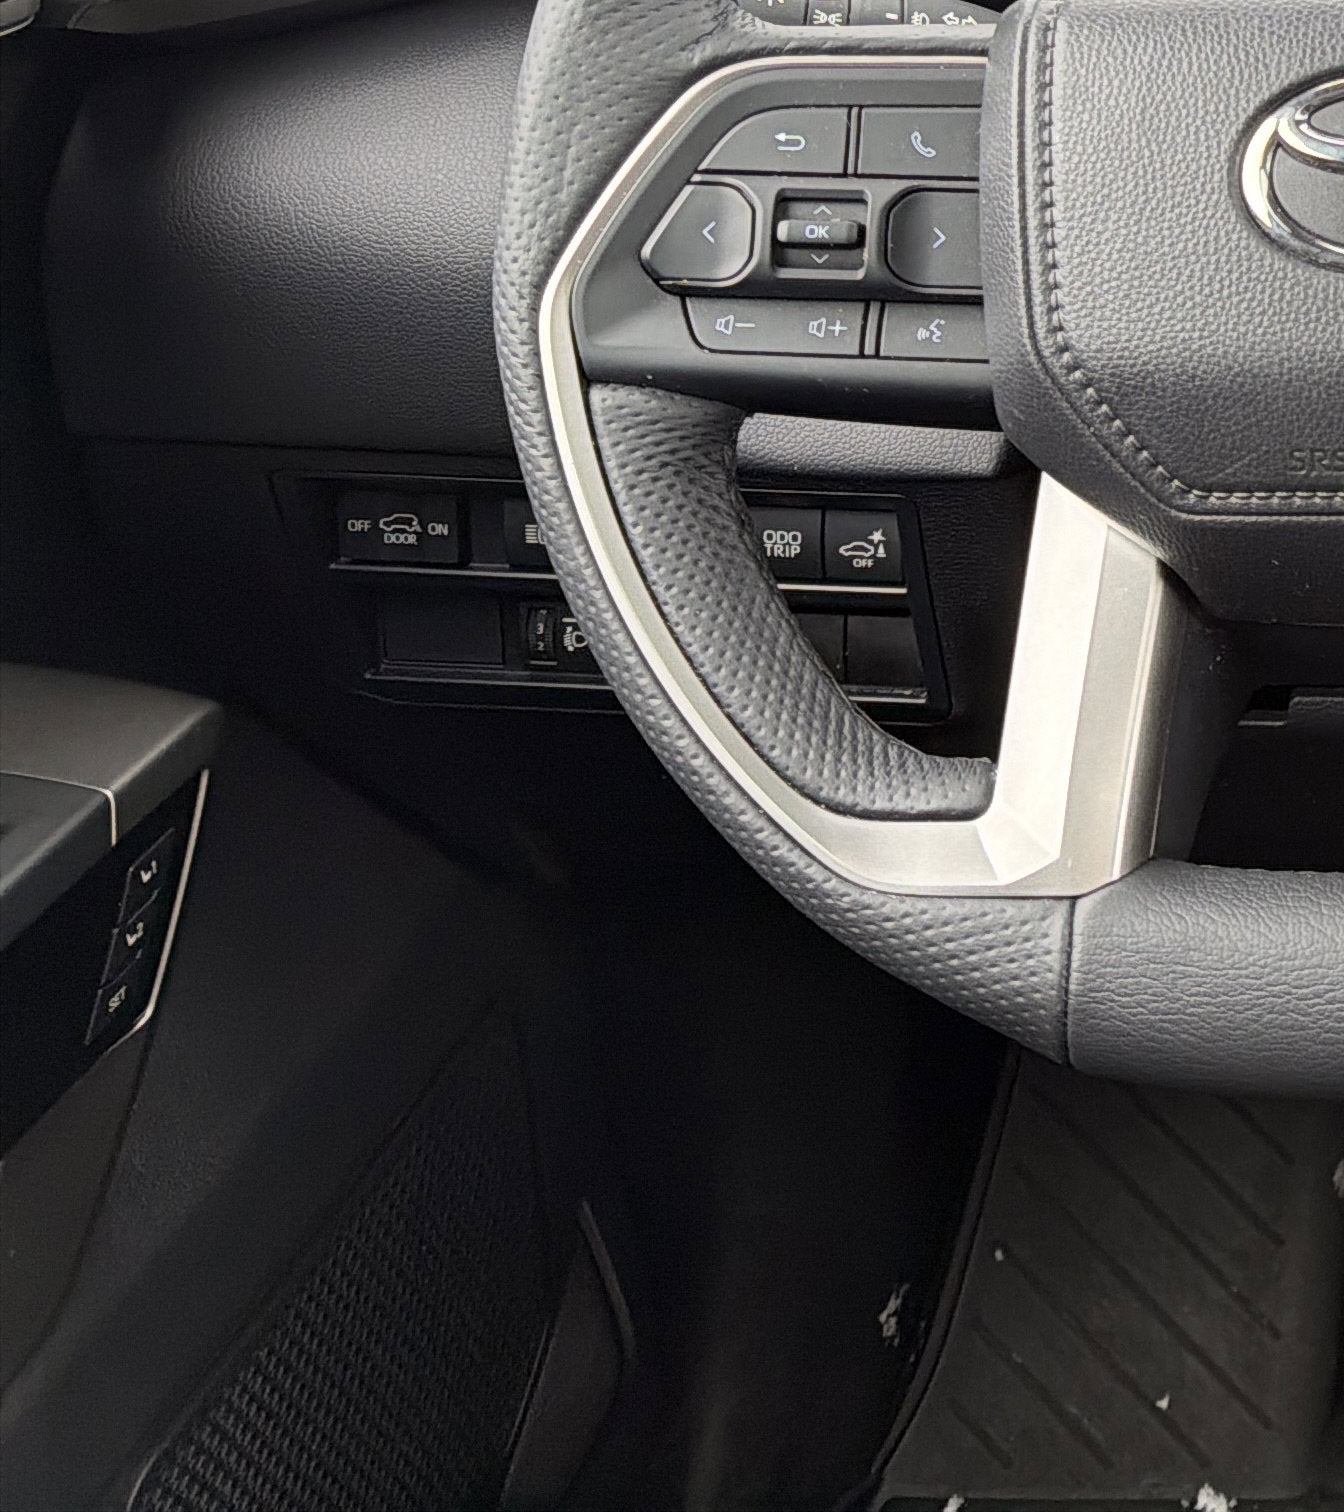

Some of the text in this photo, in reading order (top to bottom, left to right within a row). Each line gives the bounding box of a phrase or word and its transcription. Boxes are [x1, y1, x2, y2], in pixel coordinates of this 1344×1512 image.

[804, 225, 830, 239] OK
[347, 519, 449, 536] OFF ON
[383, 532, 418, 546] DOOR
[762, 529, 802, 546] ODO
[764, 544, 802, 559] TRIP
[852, 557, 875, 568] OFF
[537, 622, 544, 634] 3
[537, 641, 545, 651] 2
